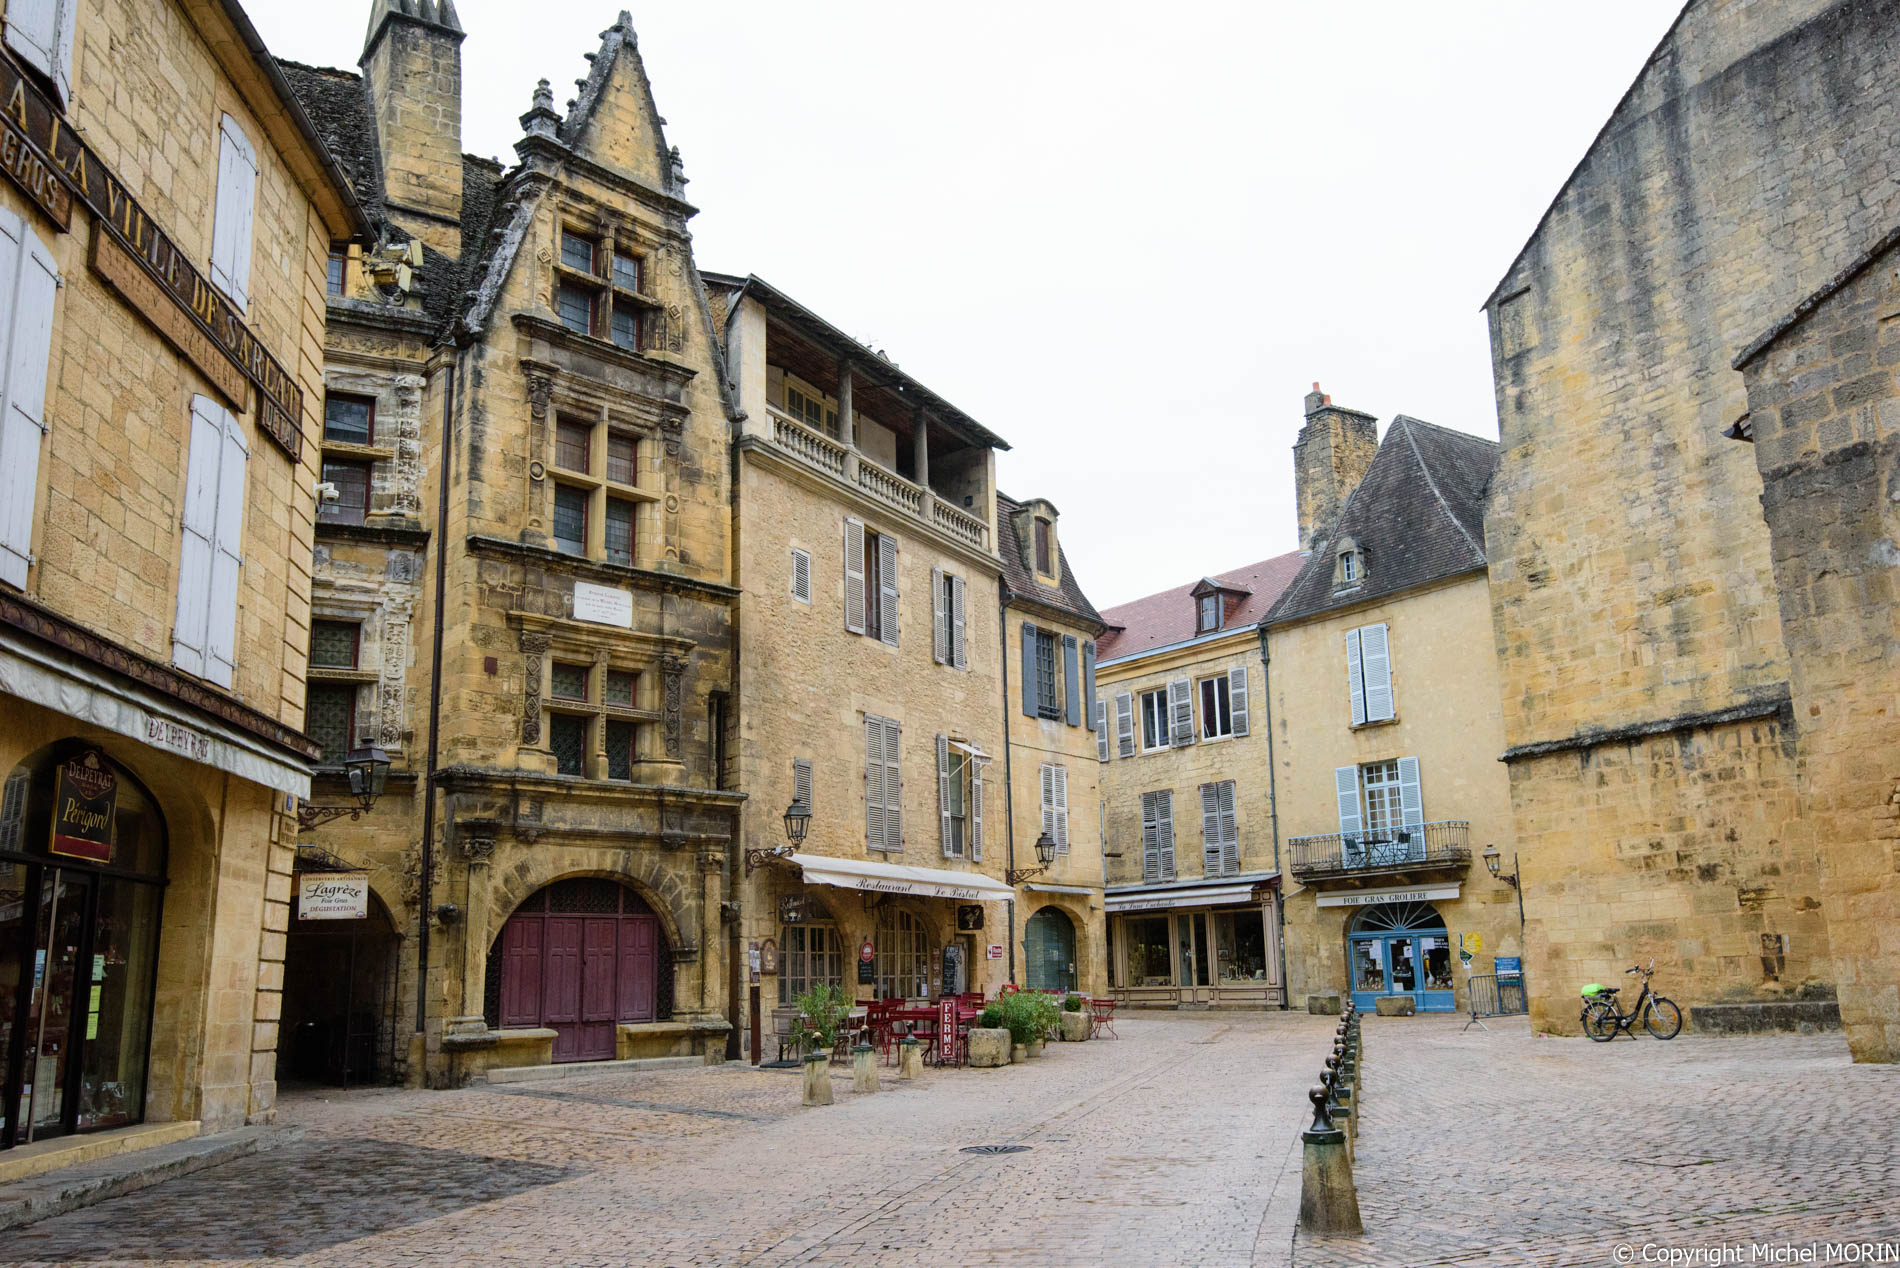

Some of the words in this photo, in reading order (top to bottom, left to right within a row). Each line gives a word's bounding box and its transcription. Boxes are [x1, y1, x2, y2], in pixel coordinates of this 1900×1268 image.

[2, 128, 59, 209] GROS
[3, 78, 28, 133] A
[47, 112, 91, 199] LA
[105, 176, 184, 291] VILLE
[224, 315, 298, 414] SARLAT
[69, 761, 113, 789] DELPEYRAT
[62, 797, 111, 834] Périgord
[305, 881, 362, 900] Lagrèze
[856, 878, 913, 893] Restaurant
[1343, 896, 1360, 905] FOIE
[1364, 895, 1385, 904] GRAS
